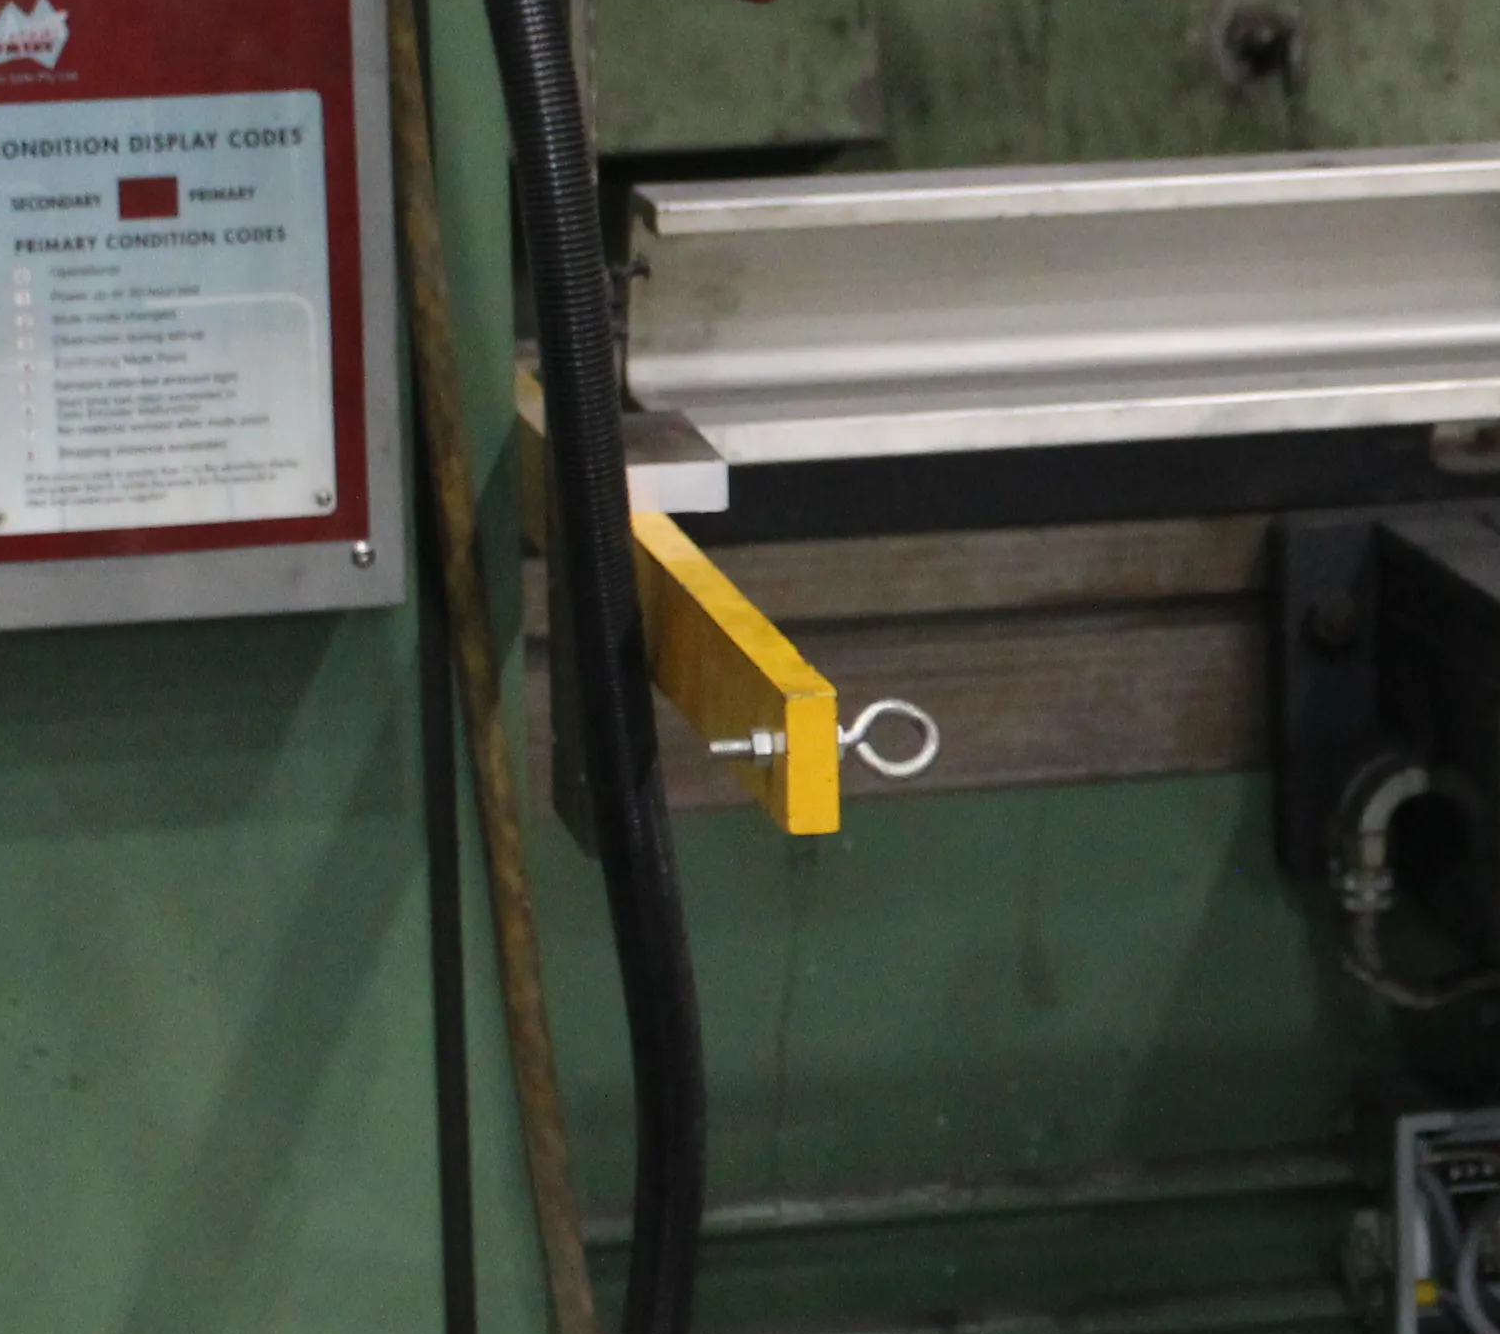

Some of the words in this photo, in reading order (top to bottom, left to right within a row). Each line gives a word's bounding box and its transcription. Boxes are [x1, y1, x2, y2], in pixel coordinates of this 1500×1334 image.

[129, 130, 218, 154] DISPLAY
[228, 126, 304, 150] CODES
[14, 237, 97, 255] PRIMARY
[106, 230, 216, 251] CONDITION
[224, 225, 287, 245] CODES
